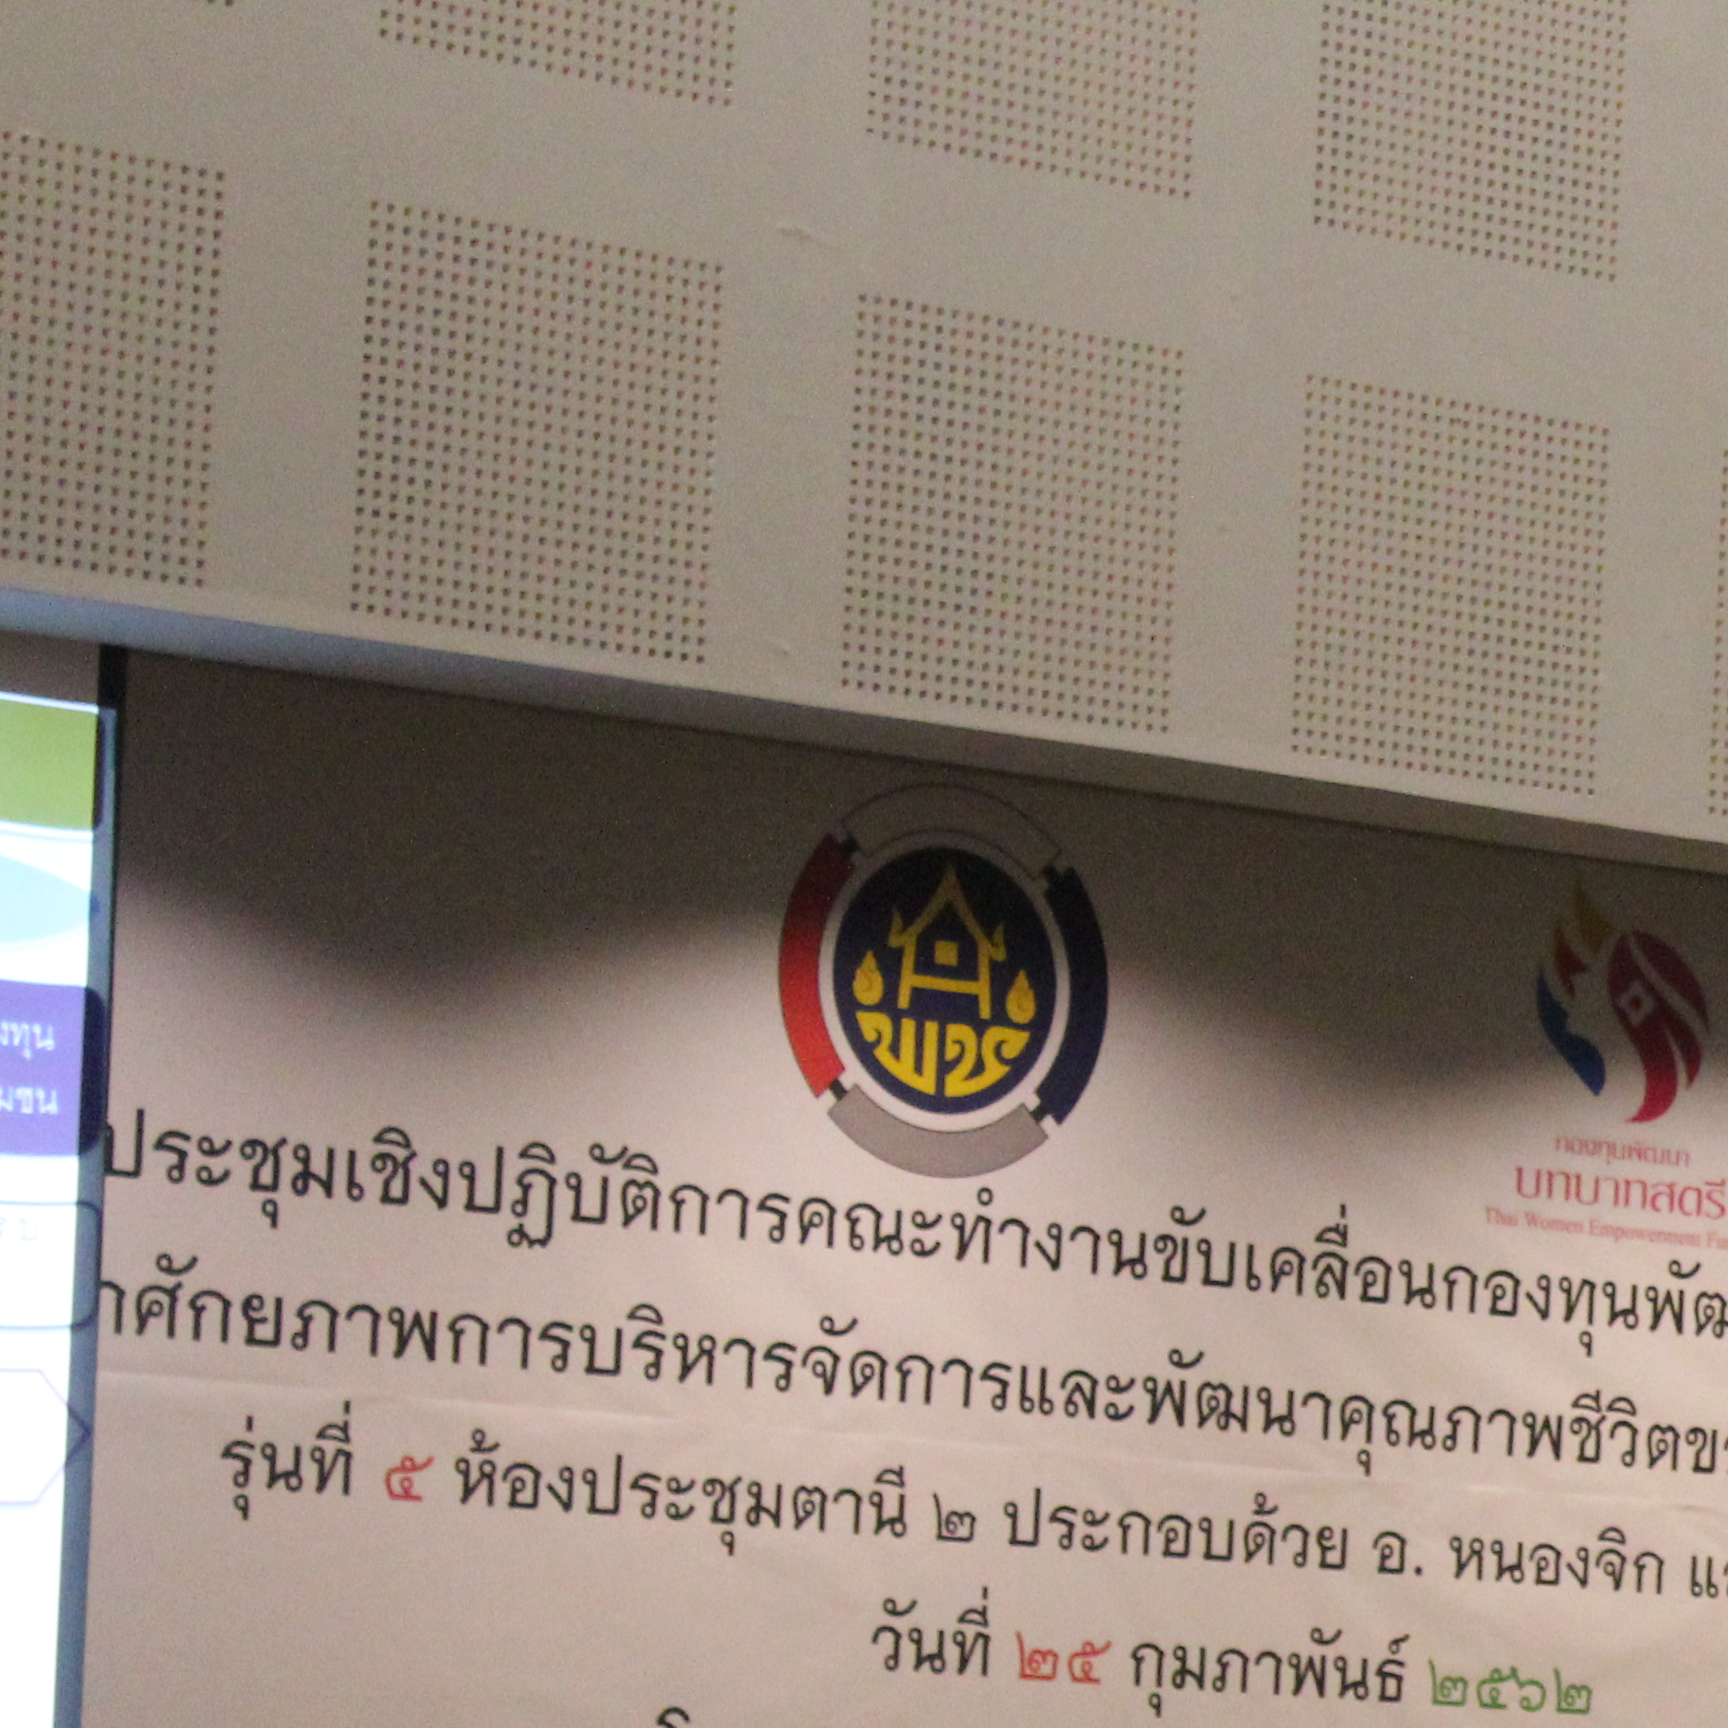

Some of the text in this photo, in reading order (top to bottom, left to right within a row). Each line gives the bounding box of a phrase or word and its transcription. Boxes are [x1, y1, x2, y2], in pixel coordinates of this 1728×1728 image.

[1485, 1205, 1519, 1227] Thai
[1524, 1211, 1584, 1234] Women
[1515, 1164, 1727, 1221] บทบาทสตรี
[220, 1400, 353, 1521] รุ่นที่
[384, 1455, 435, 1502] ๕
[454, 1428, 908, 1557] ห้องประชุมตานี
[932, 1492, 976, 1543] ๒
[1003, 1487, 1348, 1571] ประกอบด้วย
[1372, 1530, 1423, 1577] อ.
[1448, 1526, 1665, 1595] หนองจิก
[871, 1587, 1594, 1720] วันที่ ๒๕ กุมภาพันธ์ ๒๕๖๒
